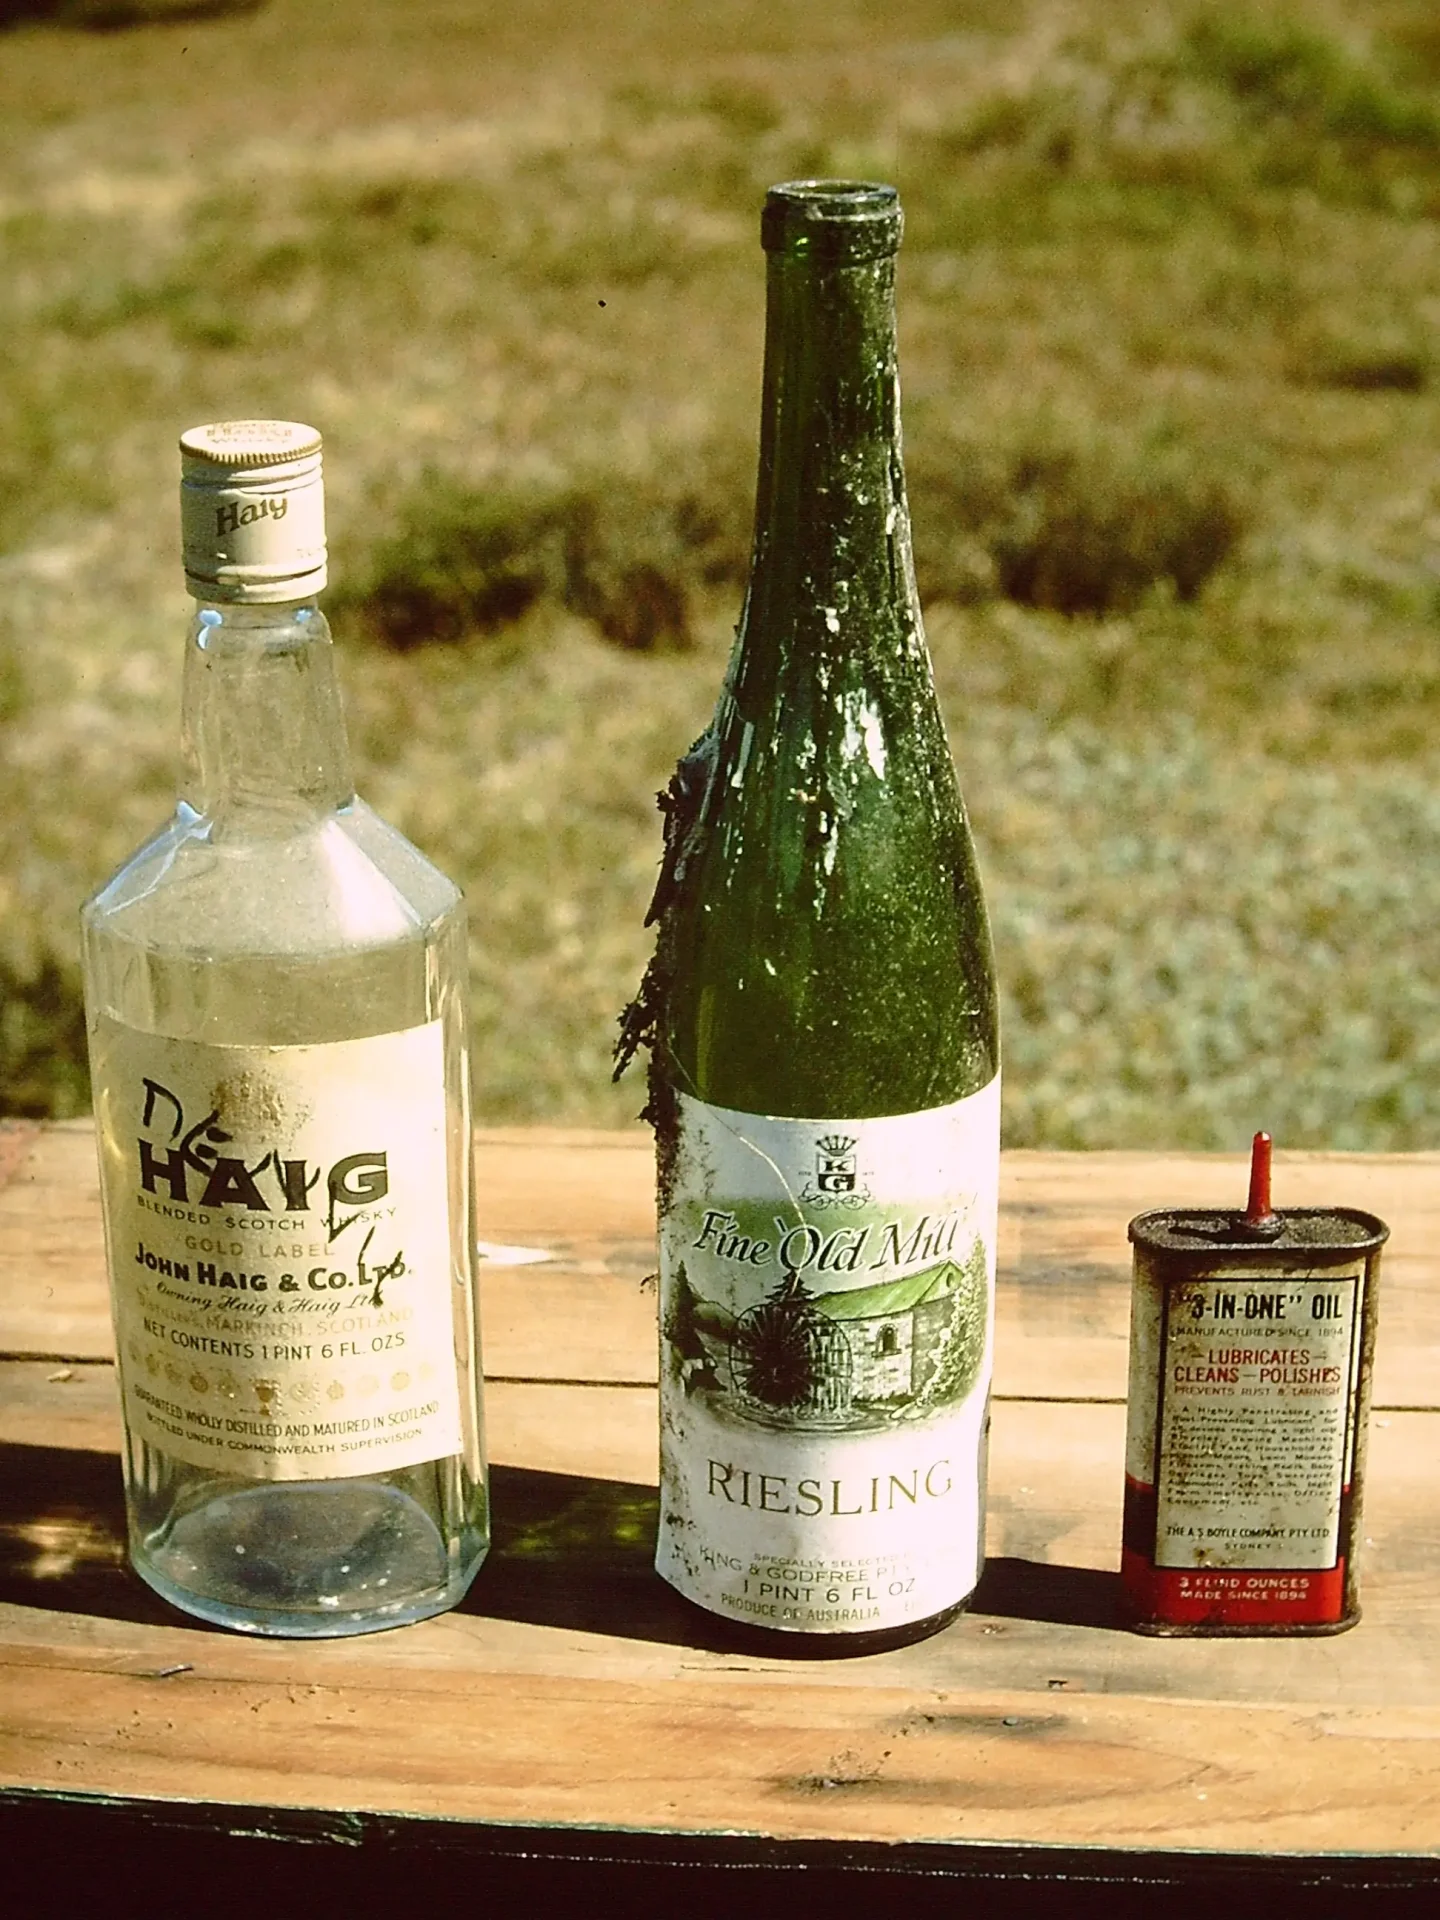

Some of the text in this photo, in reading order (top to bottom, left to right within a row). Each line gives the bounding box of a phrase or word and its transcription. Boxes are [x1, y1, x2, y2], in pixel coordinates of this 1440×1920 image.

[216, 498, 288, 537] Haig
[137, 1138, 388, 1211] HAIG
[823, 1160, 852, 1173] K
[825, 1176, 849, 1190] G
[137, 1195, 396, 1231] BLENDED SCOTCH WHISKY
[185, 1235, 336, 1260] GOLD LABEL
[693, 1209, 962, 1273] Fine Old Mill
[135, 1243, 190, 1281] JOHN
[197, 1262, 268, 1292] HAIG
[279, 1274, 300, 1292] &
[157, 1281, 213, 1311] Owning
[217, 1294, 269, 1318] Haig
[272, 1299, 285, 1314] &
[288, 1297, 341, 1318] Haig
[1311, 1294, 1343, 1320] OIL
[316, 1308, 414, 1336] SCOTLAND
[1176, 1326, 1273, 1338] MANUFACTURED
[1277, 1326, 1310, 1338] SINCE
[143, 1317, 166, 1338] NET
[170, 1329, 255, 1359] CONTENTS
[273, 1345, 312, 1360] PINT
[321, 1344, 334, 1359] 6
[371, 1332, 405, 1352] OZS
[1208, 1349, 1311, 1366] LUBRICATES
[1174, 1366, 1341, 1384] CLEANS POLISHES
[1174, 1386, 1341, 1397] PREVENTS RUST & TARNISH
[185, 1408, 223, 1430] WHOLLY
[225, 1419, 283, 1438] DISTILLED
[284, 1424, 310, 1438] AND
[313, 1418, 371, 1436] MATURED
[373, 1416, 384, 1429] IN
[387, 1400, 440, 1427] SCOTLAND
[186, 1430, 224, 1447] UNDER
[227, 1439, 336, 1456] COMMONWEALTH
[340, 1427, 423, 1453] SUPERVISION
[707, 1458, 952, 1517] RIESLING
[1167, 1526, 1184, 1537] THE
[1207, 1527, 1237, 1538] BOYLE
[1239, 1527, 1286, 1539] COMPANY
[1289, 1528, 1309, 1538] PTY
[1225, 1542, 1272, 1550] SYDNEY
[700, 1545, 742, 1571] KING
[749, 1562, 760, 1577] &
[767, 1566, 869, 1583] GODFREE
[754, 1553, 825, 1568] SPECIALLY
[760, 1582, 815, 1602] PINT
[826, 1587, 840, 1604] 6
[851, 1586, 878, 1602] FL
[888, 1577, 915, 1597] OZ
[1179, 1577, 1189, 1588] 3
[1246, 1577, 1310, 1588] OUNCES
[1180, 1590, 1222, 1600] MADE
[1227, 1590, 1269, 1600] SINCE
[721, 1592, 880, 1622] PRODUCE OF AUSTRALIA
